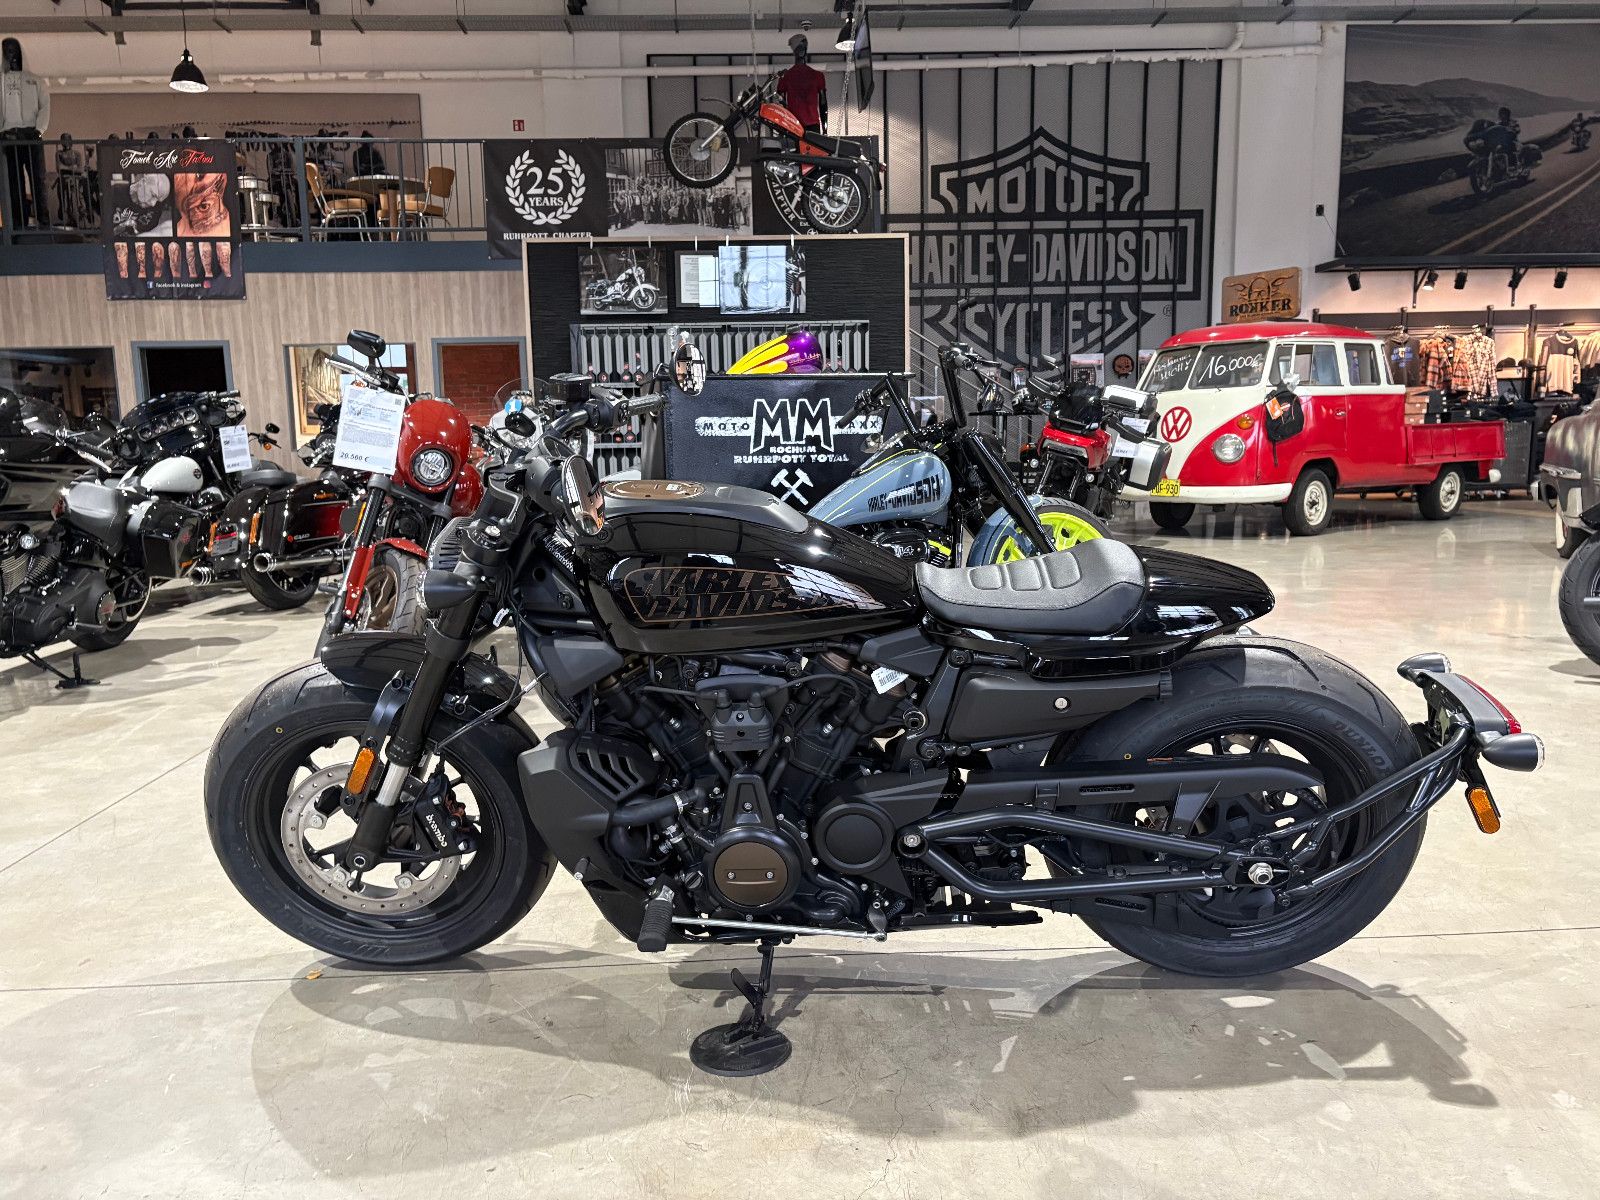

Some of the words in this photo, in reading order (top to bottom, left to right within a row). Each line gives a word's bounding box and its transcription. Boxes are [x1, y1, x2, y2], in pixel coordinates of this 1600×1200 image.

[526, 166, 564, 194] 25
[966, 157, 1116, 213] MOTOR
[527, 196, 564, 207] YEARS
[1229, 297, 1292, 317] ROKKER
[965, 300, 1113, 363] CYCLES
[702, 422, 750, 431] MOTO
[750, 398, 834, 454] MM
[733, 455, 806, 464] RUHRPOTT
[811, 453, 850, 463] TOTAL
[426, 814, 448, 848] brembo
